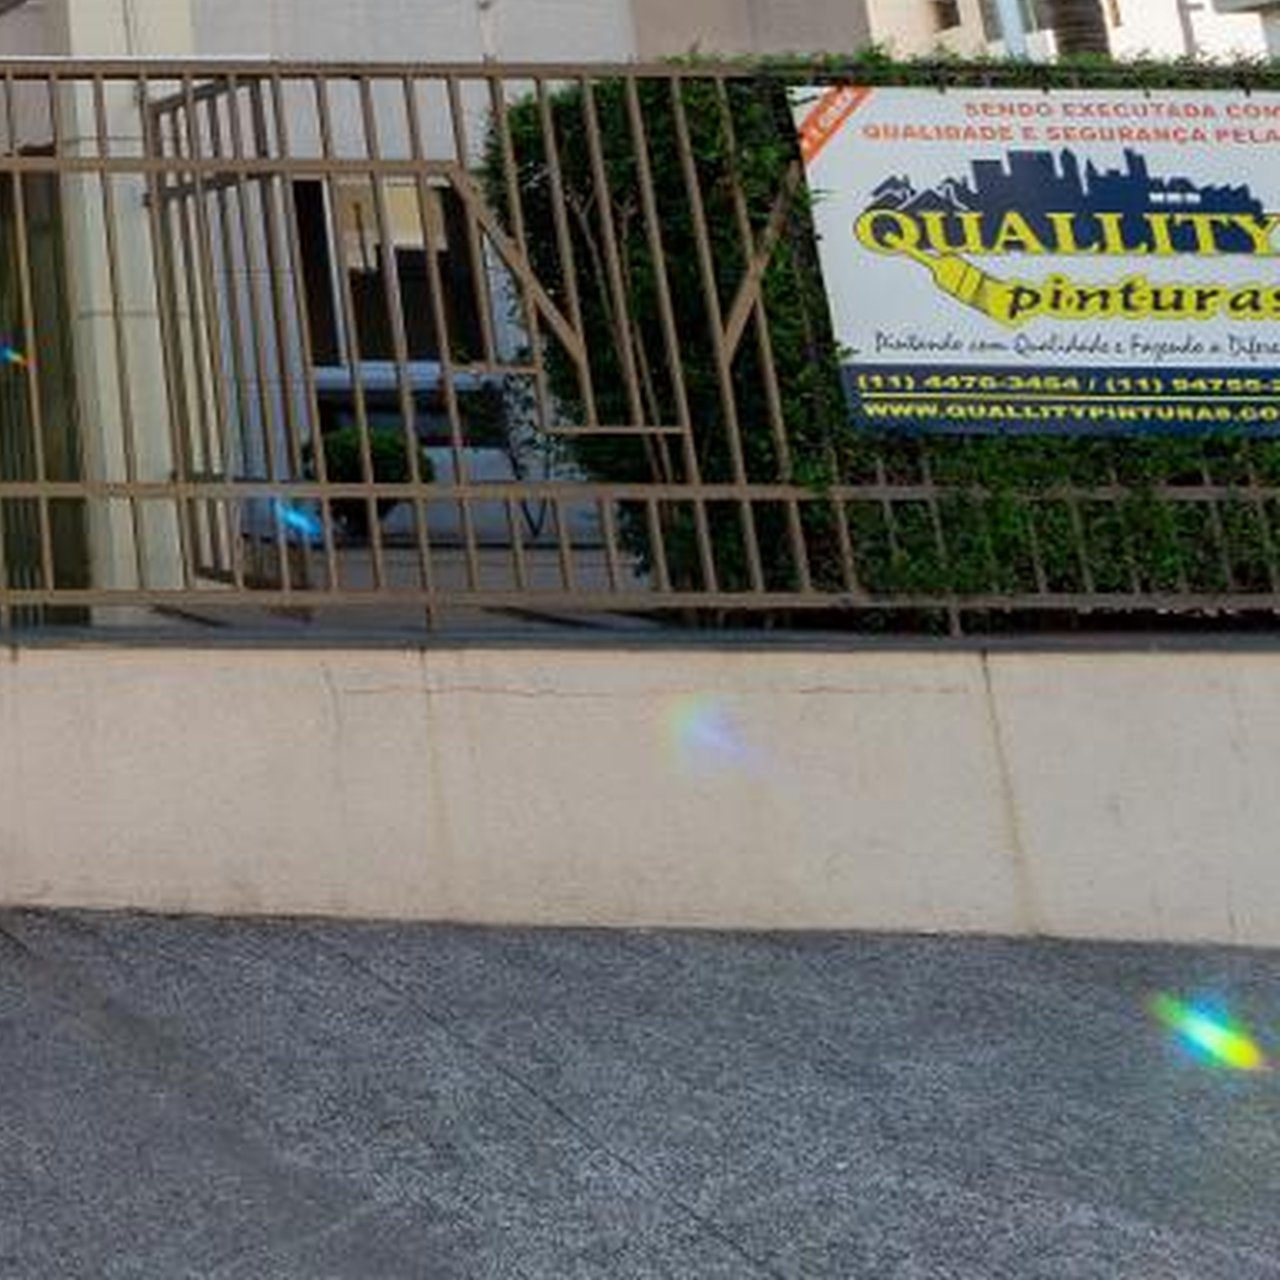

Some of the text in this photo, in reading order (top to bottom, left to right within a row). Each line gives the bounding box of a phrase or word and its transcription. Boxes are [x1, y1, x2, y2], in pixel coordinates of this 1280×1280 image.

[965, 102, 1280, 118] SENDO EXECUTADA COM
[862, 125, 1280, 144] QUALIDADE E SEGURANÇA PELA
[854, 209, 1280, 257] QUALLITY
